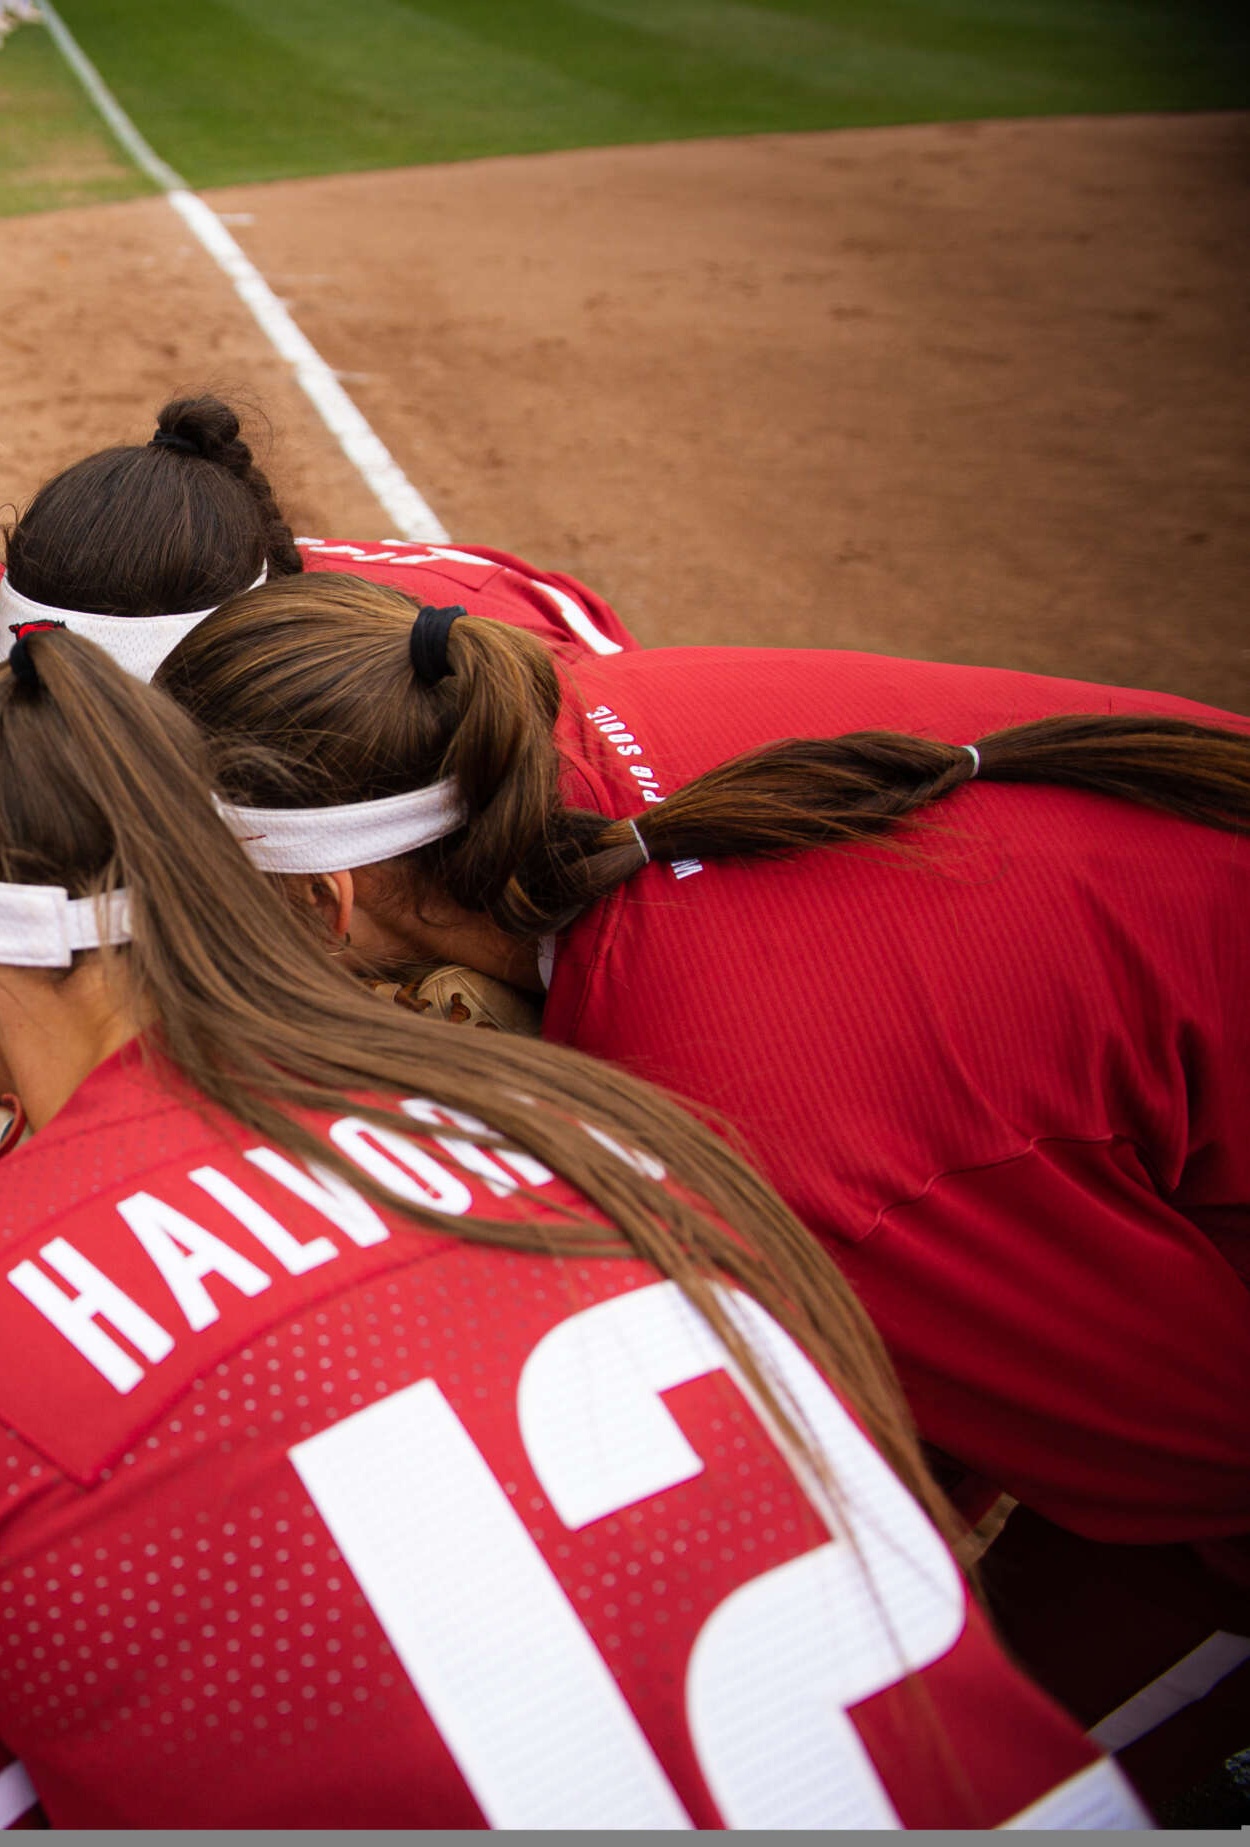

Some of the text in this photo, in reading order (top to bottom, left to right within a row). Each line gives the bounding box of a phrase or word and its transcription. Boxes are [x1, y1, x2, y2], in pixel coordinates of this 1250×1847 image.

[585, 705, 666, 803] PIG SOOIE
[7, 1097, 667, 1394] HALVOR
[289, 1280, 1154, 1829] 12
